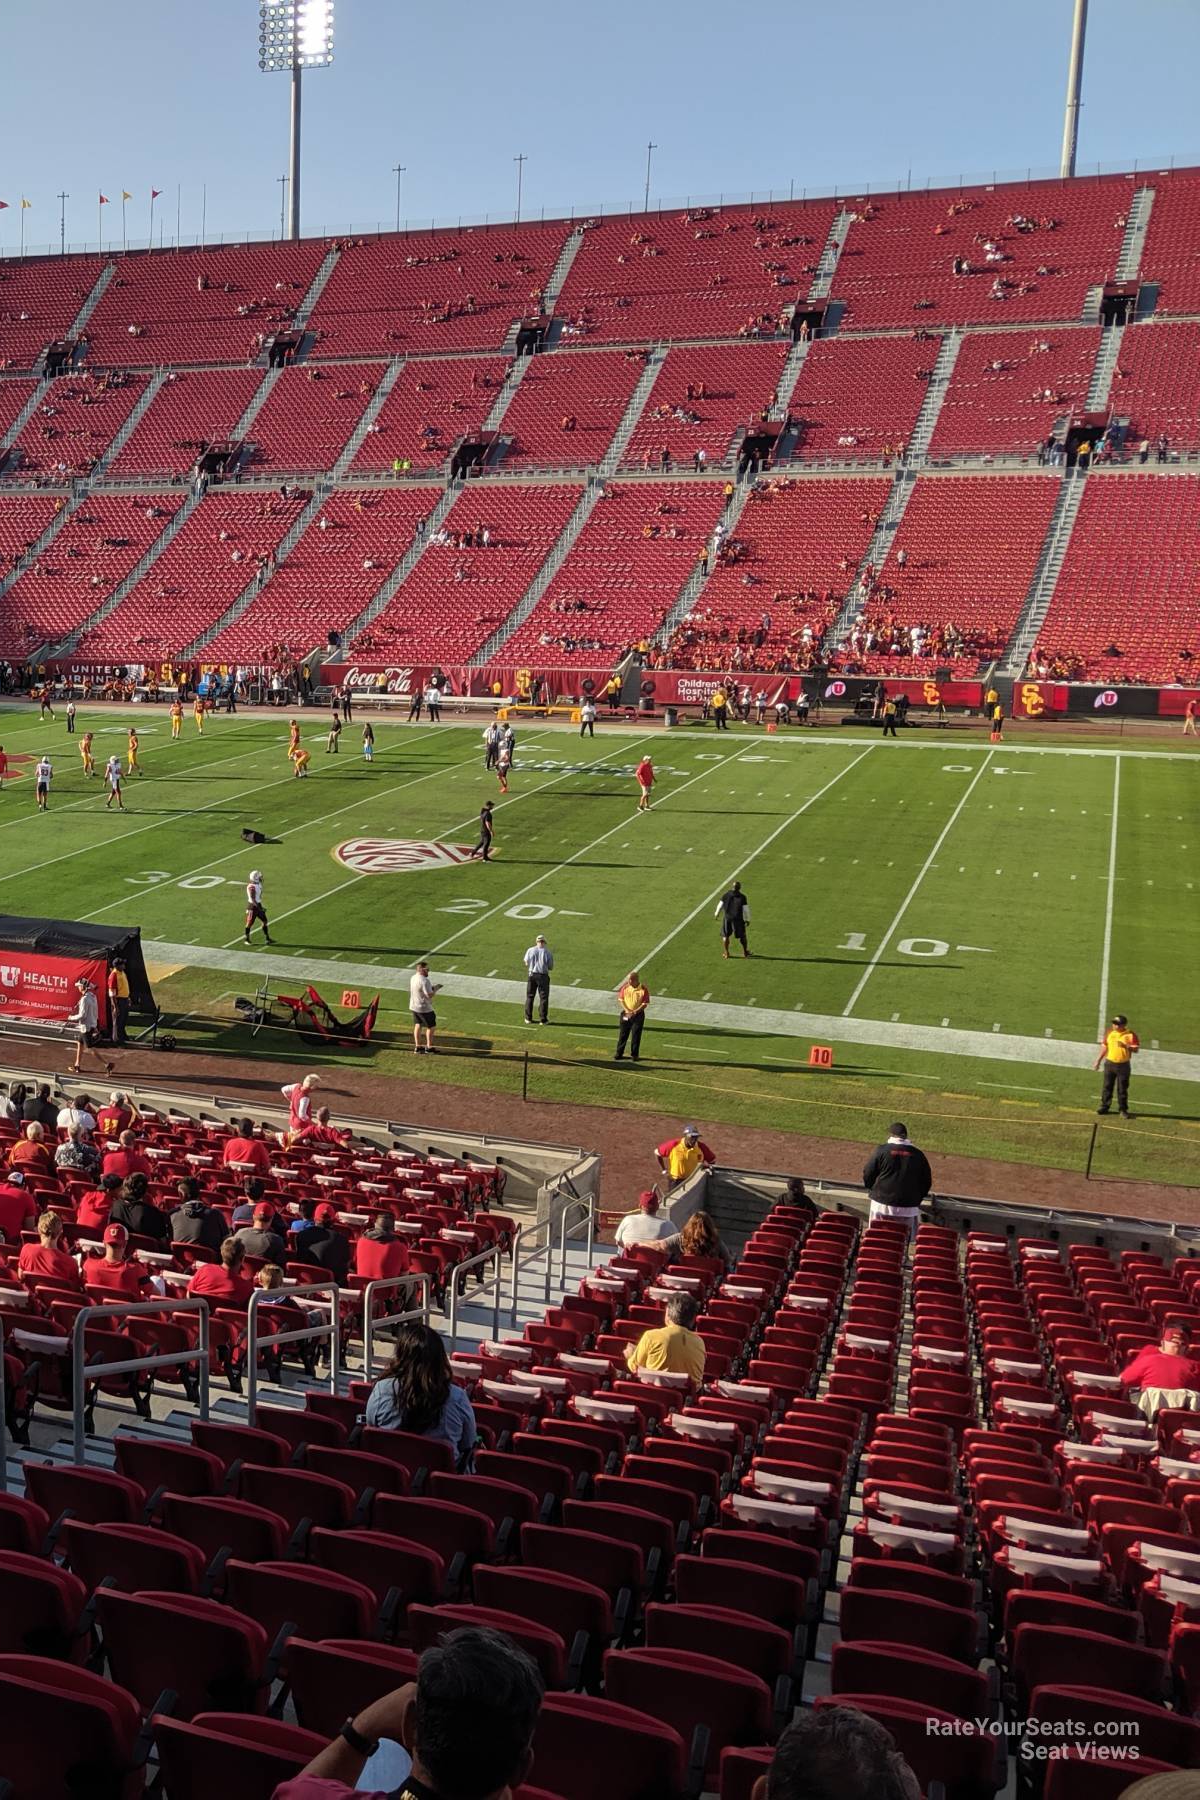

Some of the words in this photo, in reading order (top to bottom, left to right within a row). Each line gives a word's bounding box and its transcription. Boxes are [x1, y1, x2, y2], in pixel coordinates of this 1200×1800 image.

[72, 665, 116, 673] UNITE
[61, 675, 116, 685] AIRINE
[343, 667, 414, 692] CocaCola
[678, 688, 718, 697] Hospita
[23, 972, 68, 988] HEALTH
[344, 993, 358, 1006] 20
[813, 1048, 830, 1064] 10
